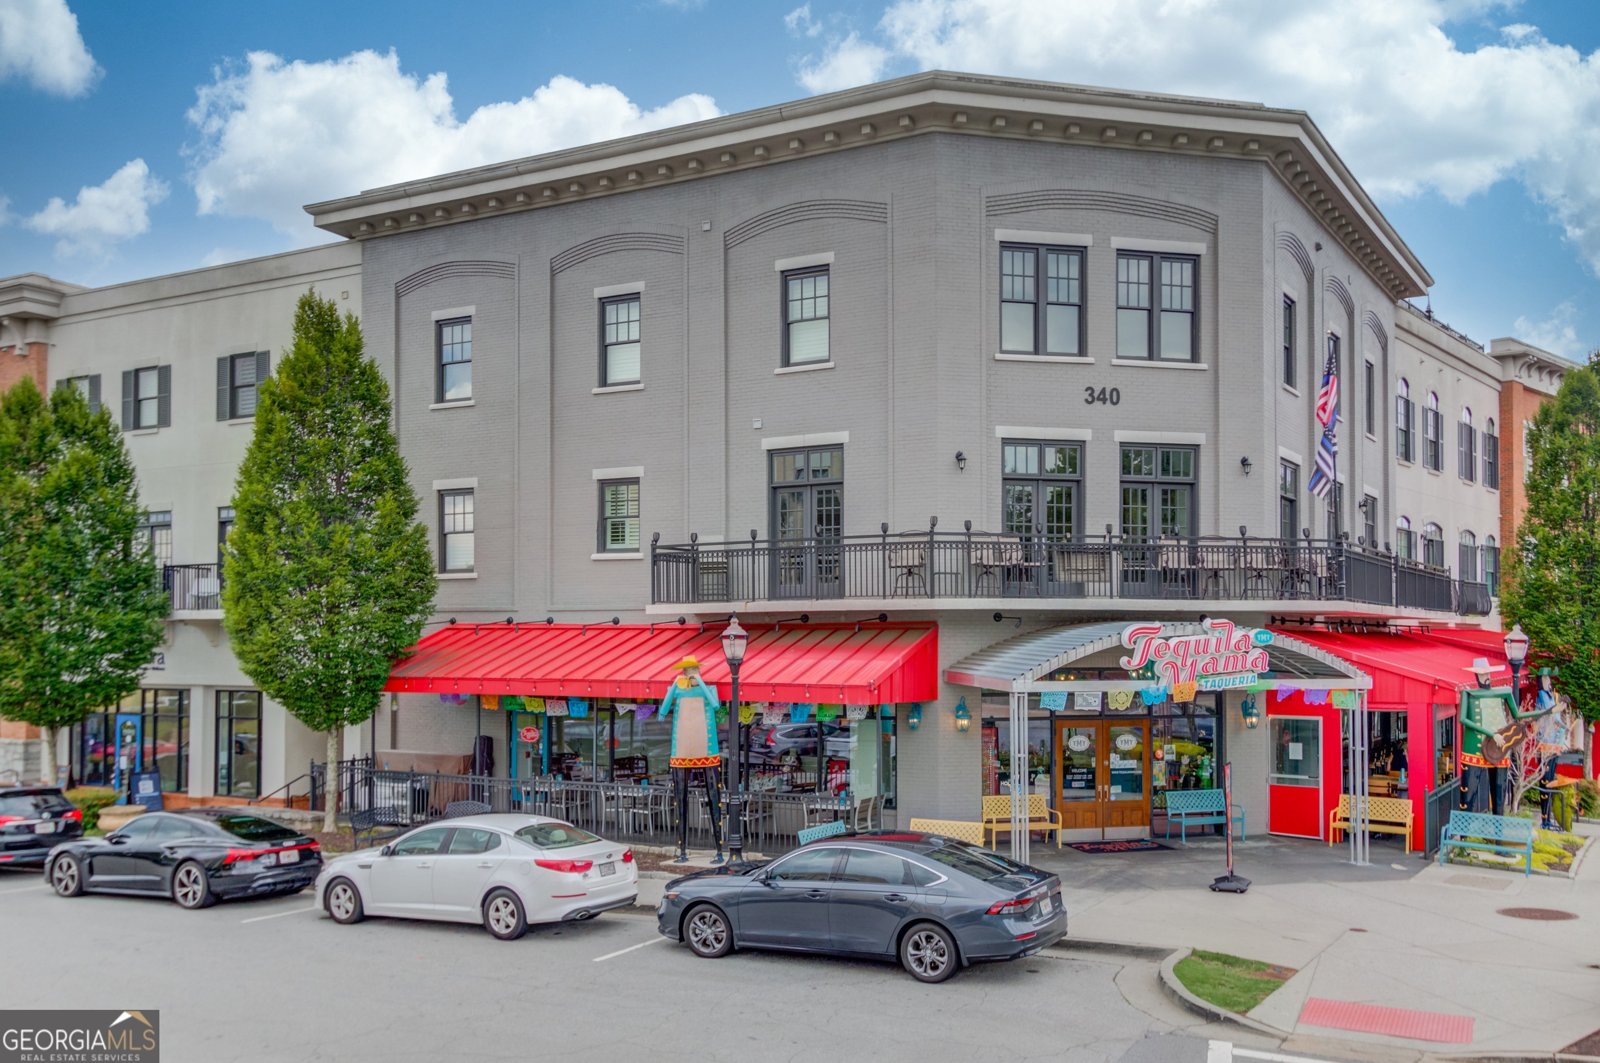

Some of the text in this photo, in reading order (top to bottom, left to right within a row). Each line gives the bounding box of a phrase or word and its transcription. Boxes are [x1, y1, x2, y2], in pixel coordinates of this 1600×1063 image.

[1084, 386, 1121, 406] 340
[1123, 619, 1252, 668] Tequila
[1161, 650, 1270, 687] Mama
[1203, 674, 1257, 689] TAQUERIA
[1073, 740, 1086, 748] TMT
[1120, 738, 1133, 747] TMT
